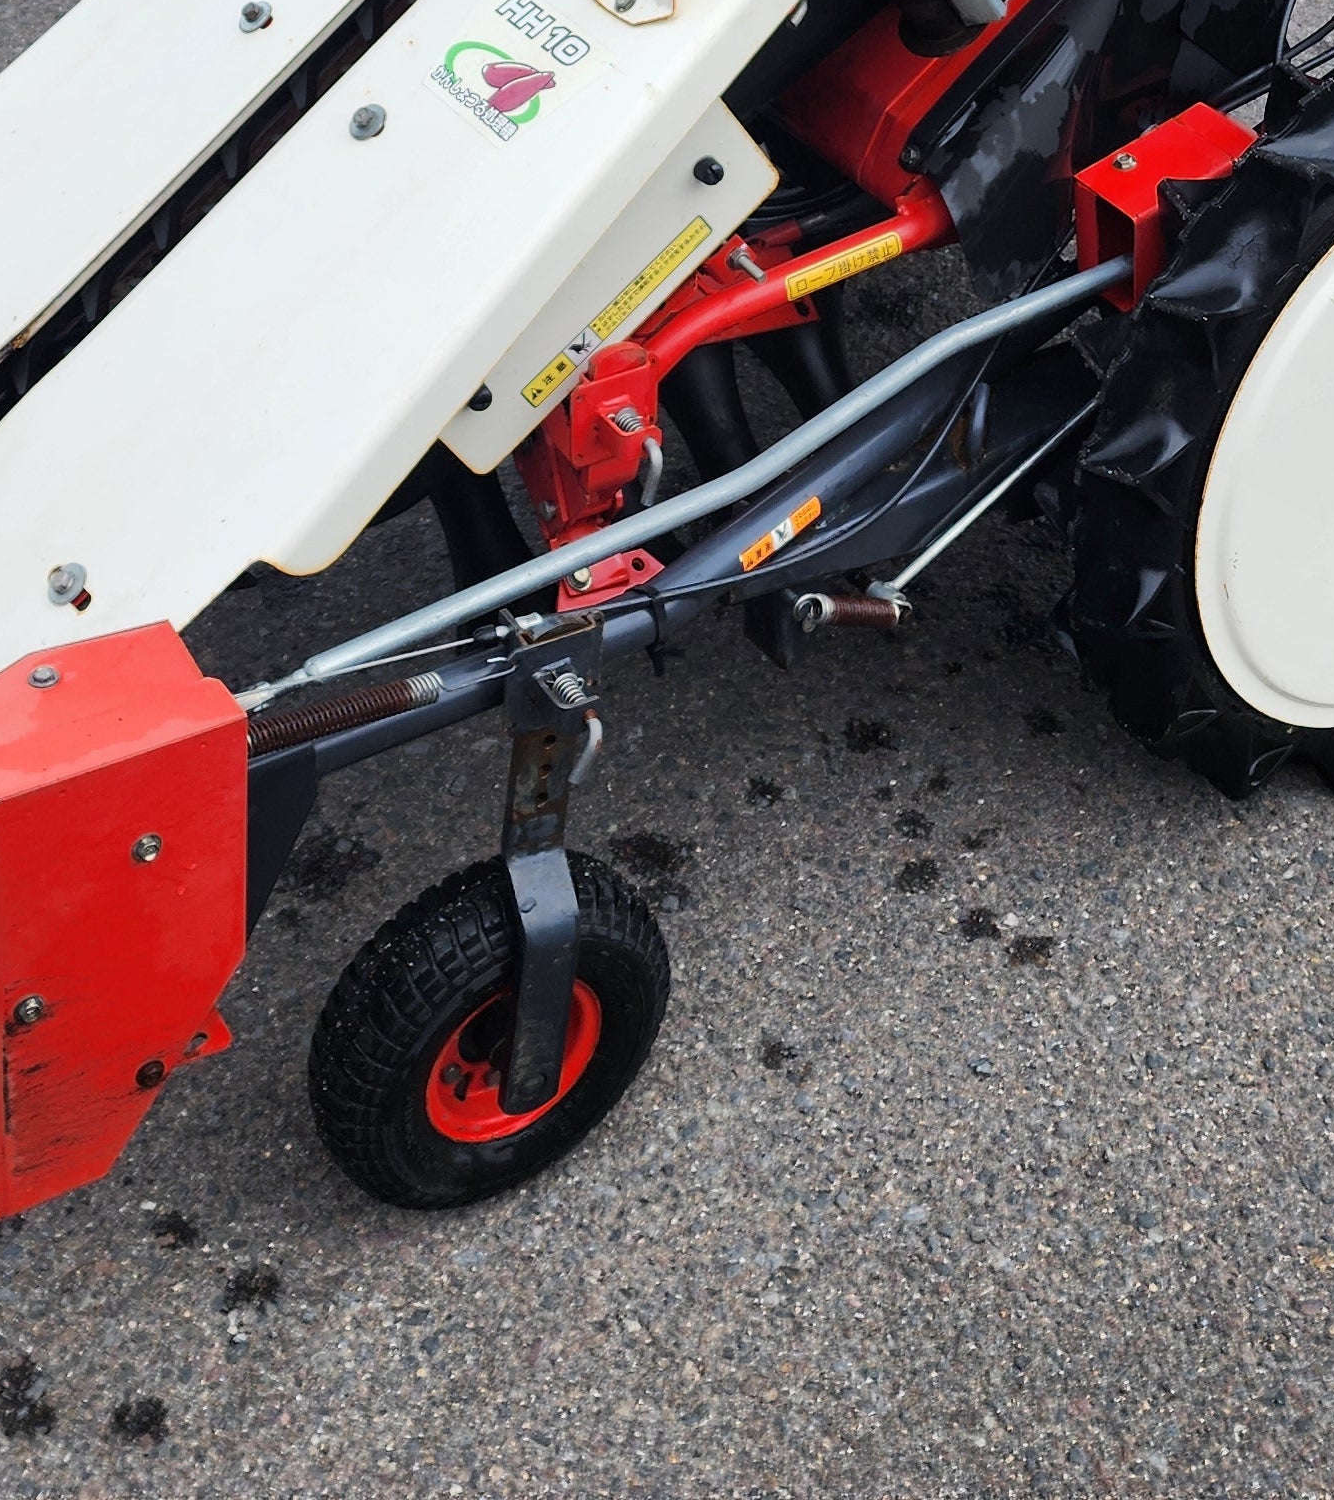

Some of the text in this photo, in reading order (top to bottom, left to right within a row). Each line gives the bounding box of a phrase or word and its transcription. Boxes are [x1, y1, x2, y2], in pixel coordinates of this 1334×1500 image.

[795, 241, 894, 293] ロープ掛け禁止
